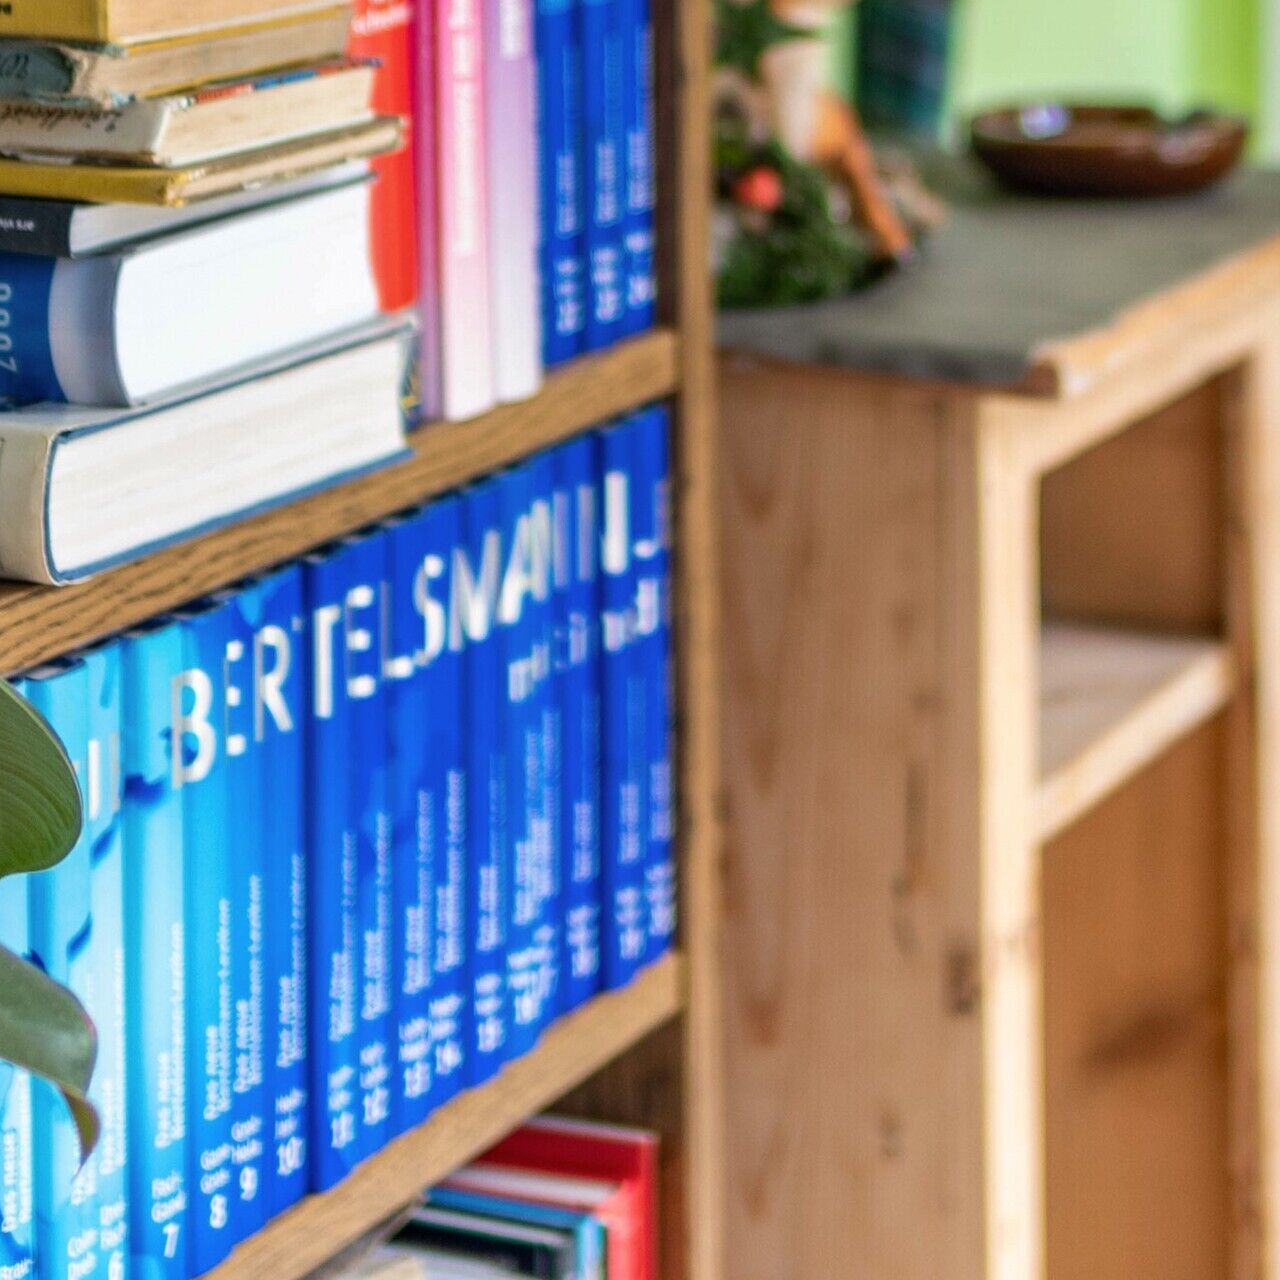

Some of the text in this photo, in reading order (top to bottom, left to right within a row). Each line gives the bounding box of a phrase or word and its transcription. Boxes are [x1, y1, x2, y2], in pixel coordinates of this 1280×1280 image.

[277, 1136, 305, 1176] 10
[240, 1167, 258, 1201] 9
[210, 1194, 227, 1229] 8
